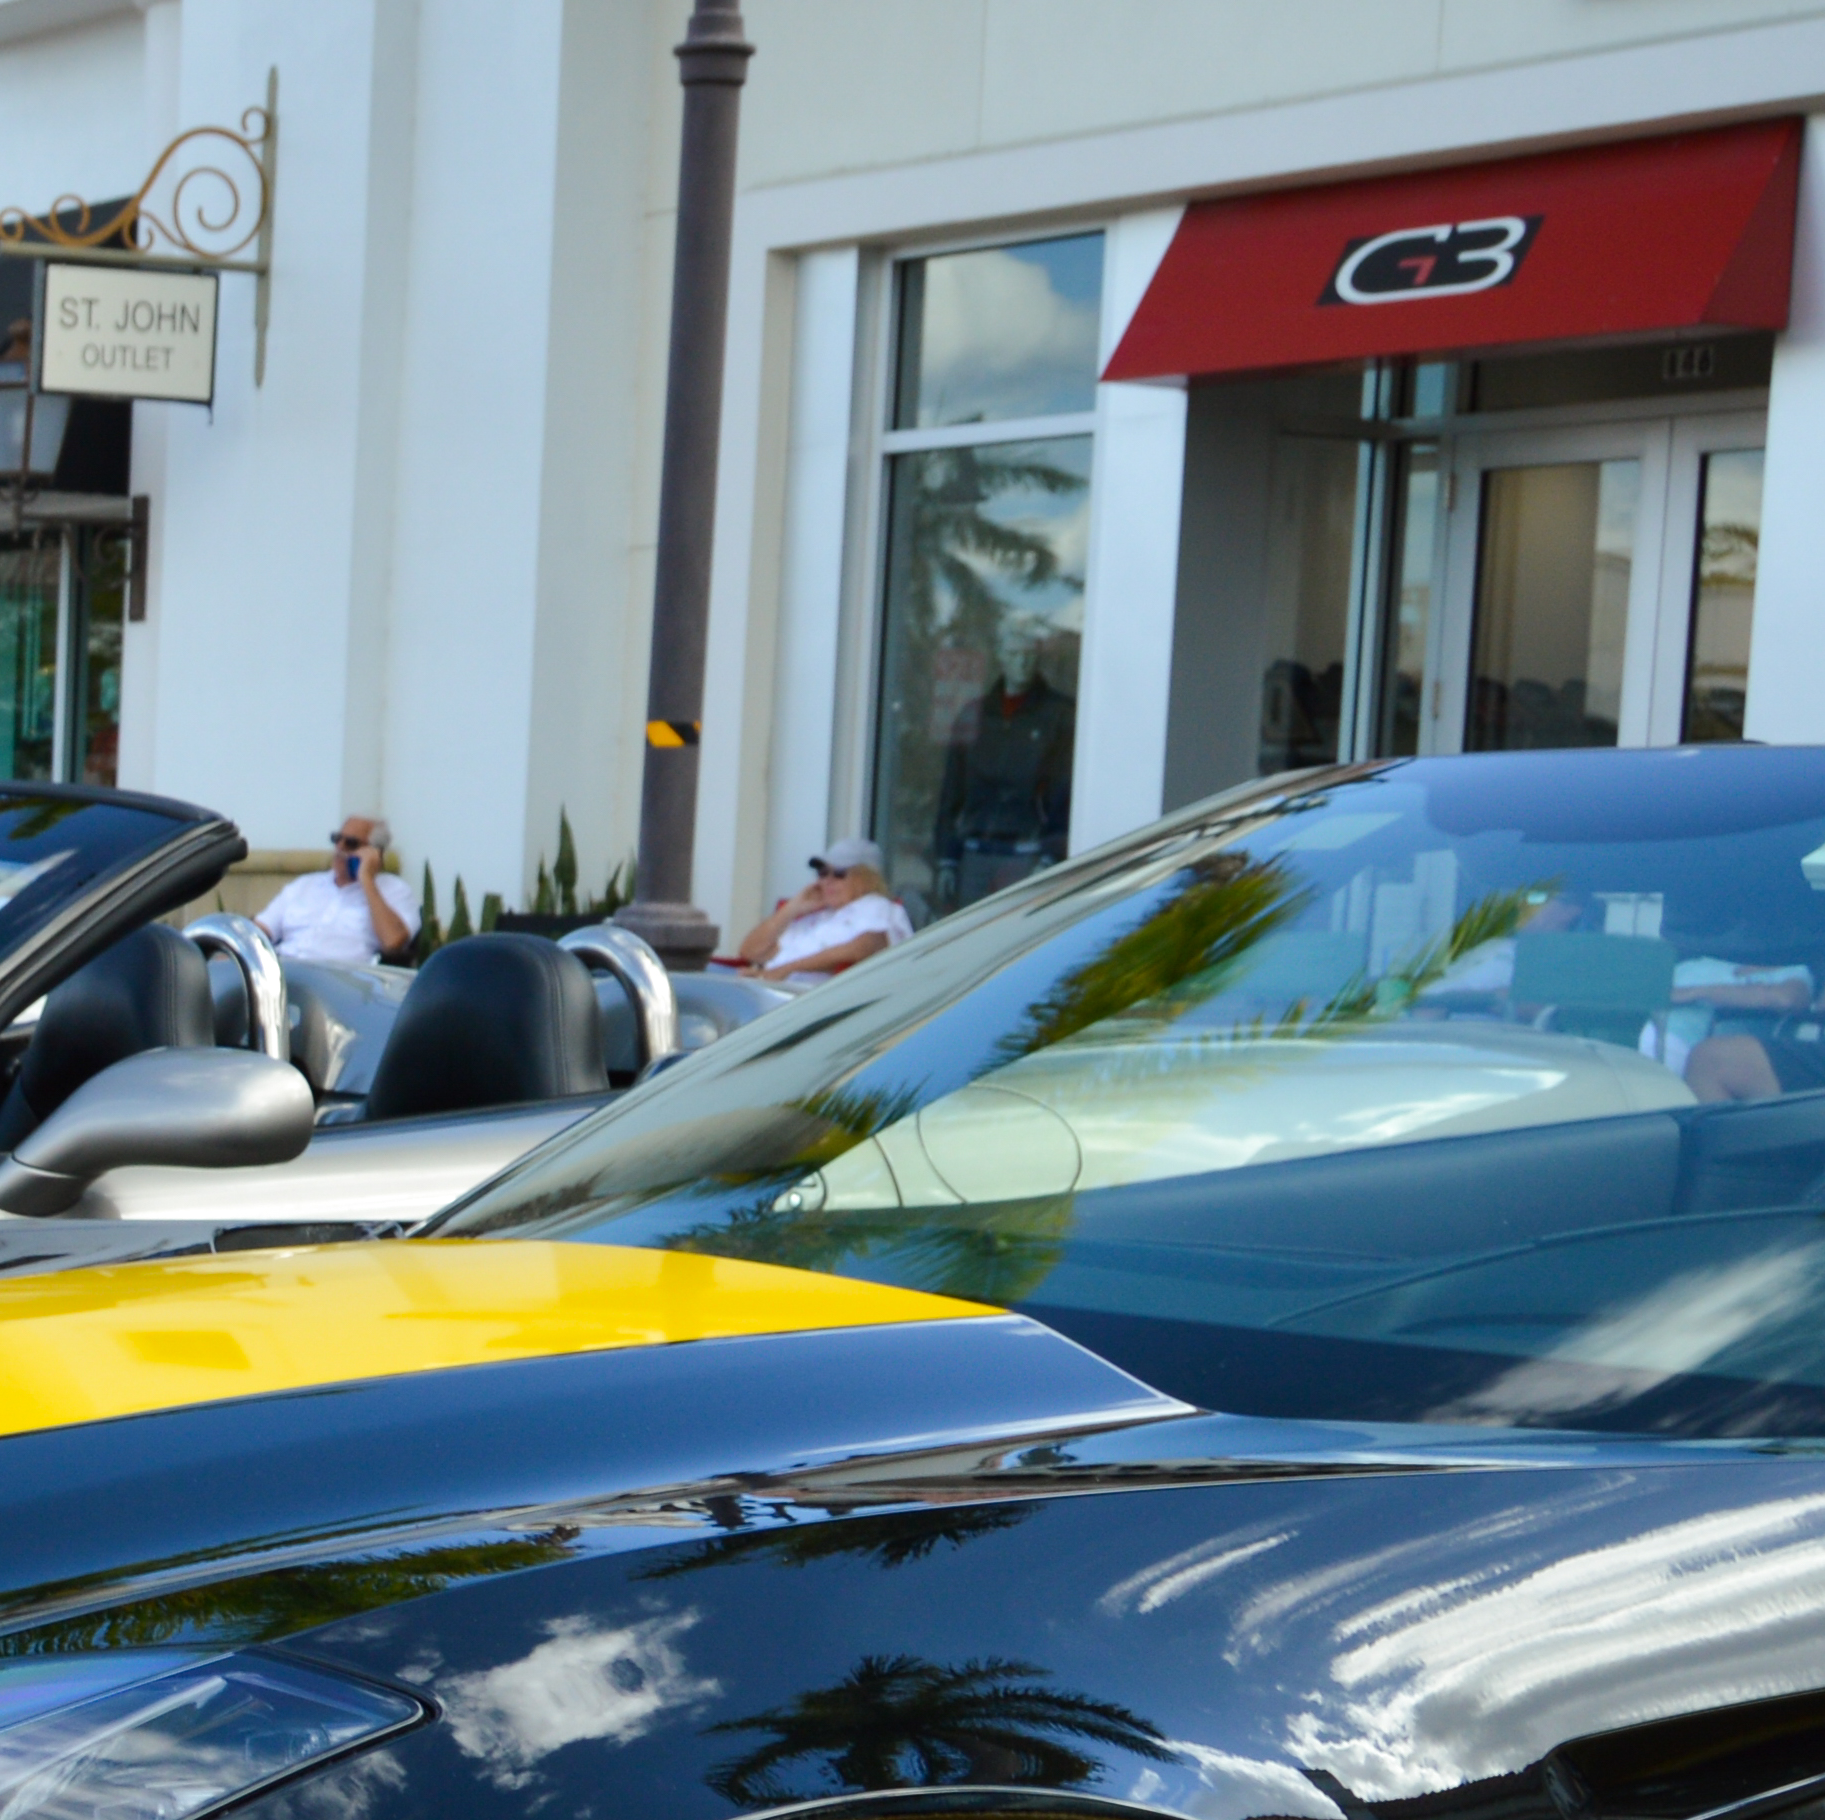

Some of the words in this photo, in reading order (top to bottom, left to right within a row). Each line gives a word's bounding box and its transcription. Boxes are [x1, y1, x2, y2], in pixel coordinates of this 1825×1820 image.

[1335, 216, 1526, 305] G3
[59, 297, 100, 330] ST.
[115, 300, 200, 333] JOHN
[82, 342, 175, 371] OUTLET
